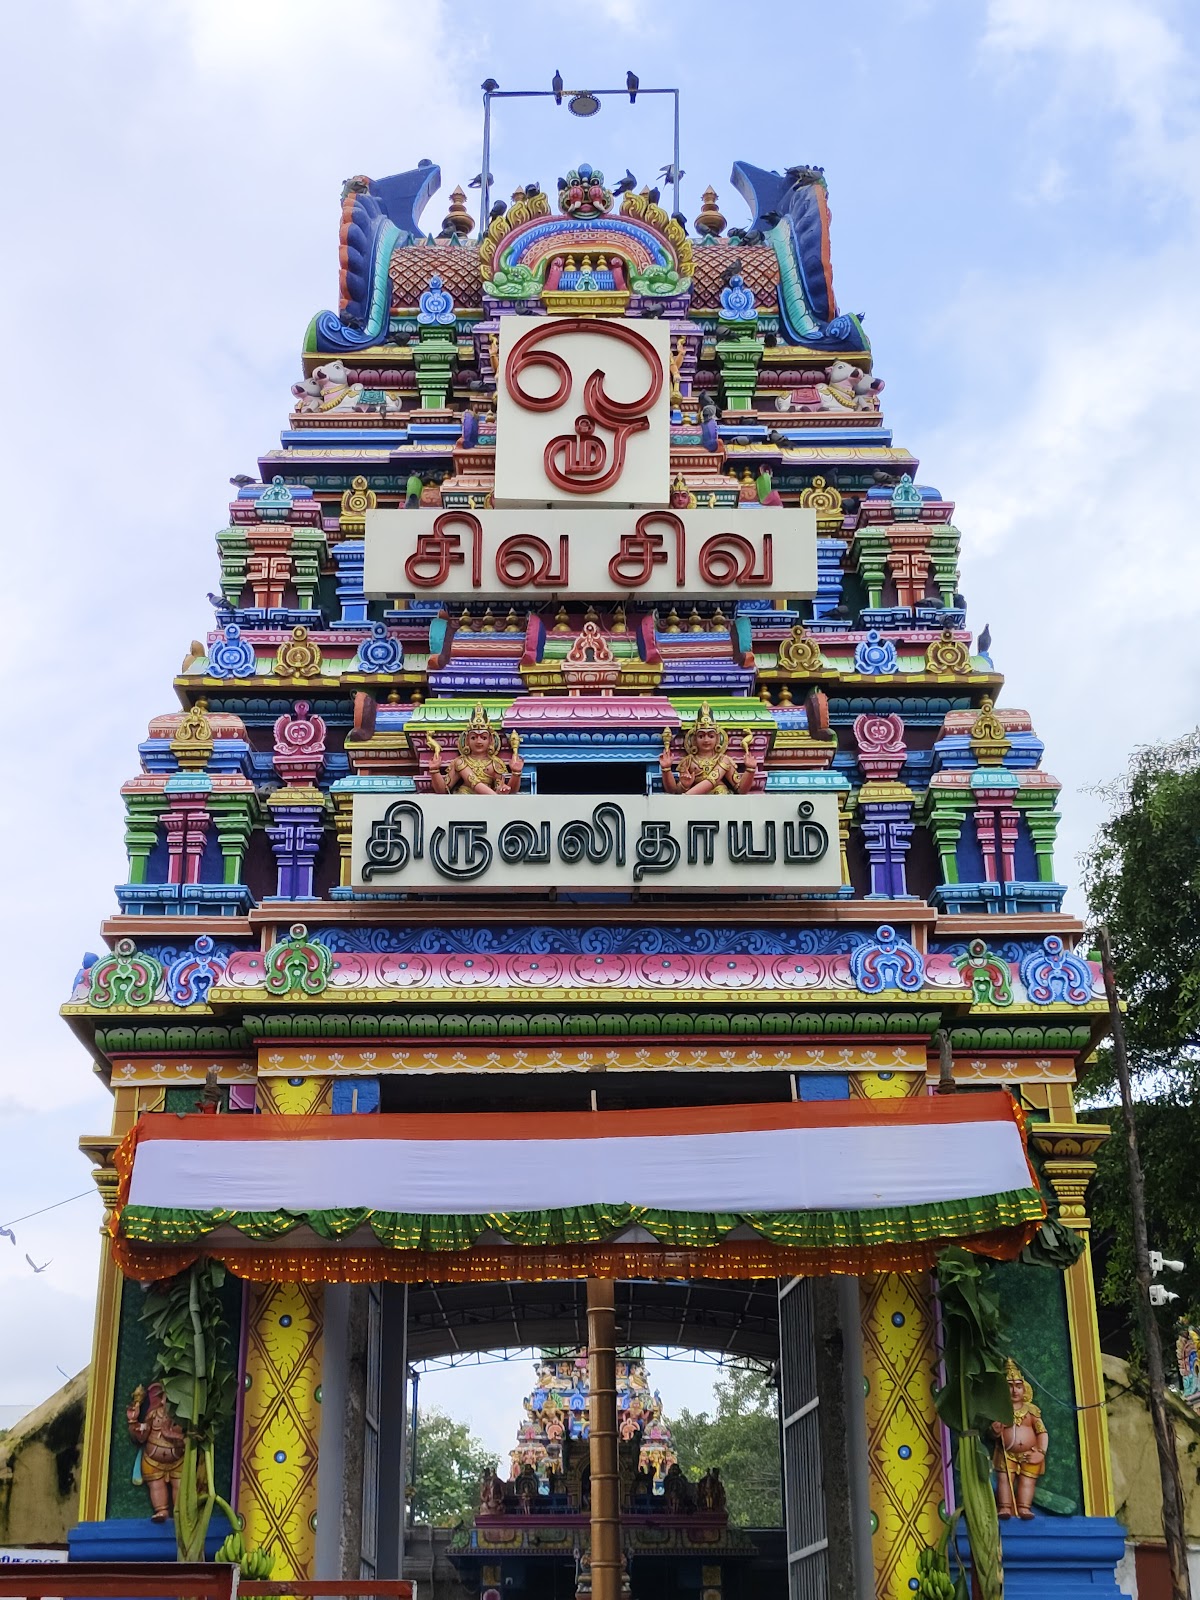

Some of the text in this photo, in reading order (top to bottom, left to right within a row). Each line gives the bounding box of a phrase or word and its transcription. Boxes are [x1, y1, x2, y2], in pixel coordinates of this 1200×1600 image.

[405, 511, 773, 588] சிவ சிவ
[361, 800, 830, 882] திருவலிதாயம்
